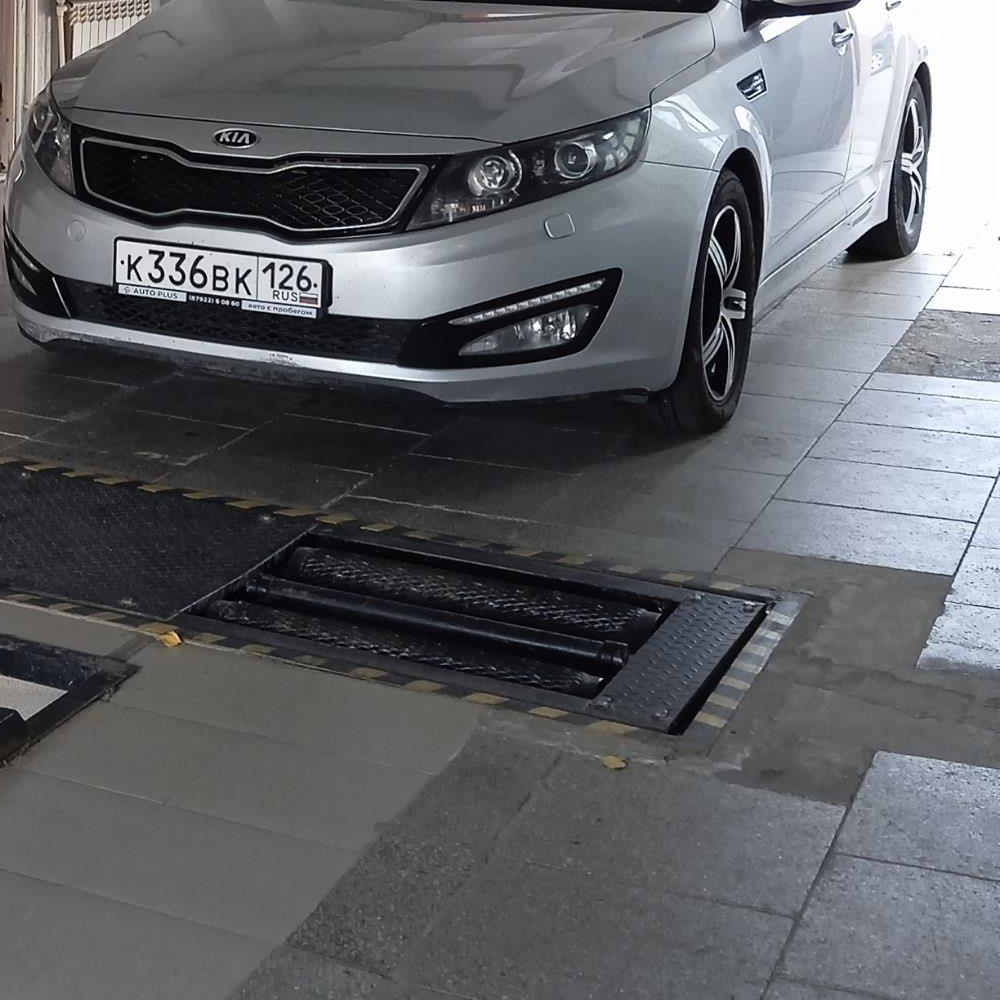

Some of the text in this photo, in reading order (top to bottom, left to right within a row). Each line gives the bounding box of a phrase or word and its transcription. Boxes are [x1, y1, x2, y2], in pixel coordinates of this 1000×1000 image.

[219, 131, 250, 144] KIA
[126, 249, 312, 296] К336ВК 126
[133, 288, 178, 300] AUTO PLUS
[272, 289, 299, 302] RUS
[273, 306, 313, 316] пробегом
